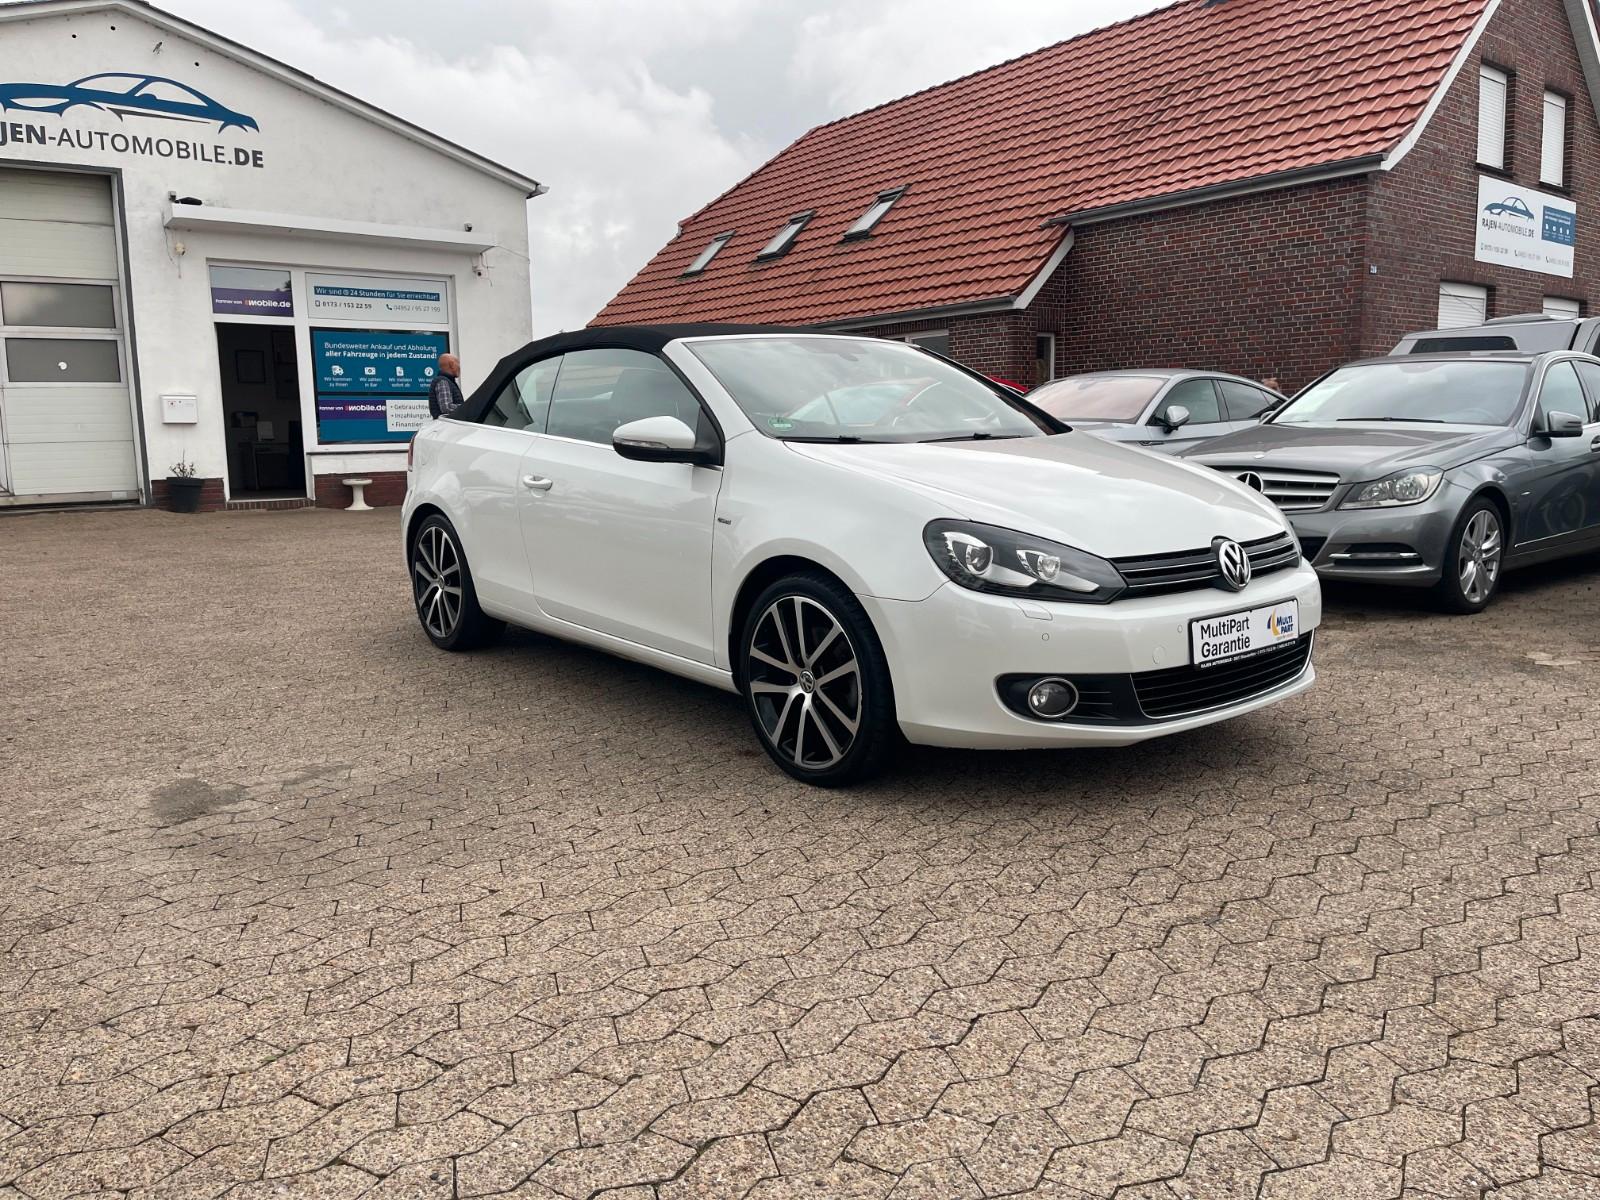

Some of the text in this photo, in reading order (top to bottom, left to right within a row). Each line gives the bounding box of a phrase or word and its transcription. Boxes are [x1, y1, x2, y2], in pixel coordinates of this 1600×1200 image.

[359, 290, 385, 298] Stunden
[248, 300, 291, 308] mobile.de
[407, 344, 437, 352] Abholung
[343, 351, 378, 359] Fahrzeuge
[1200, 616, 1250, 640] MultiPart
[1280, 624, 1294, 634] PART
[1201, 634, 1250, 658] Garantie
